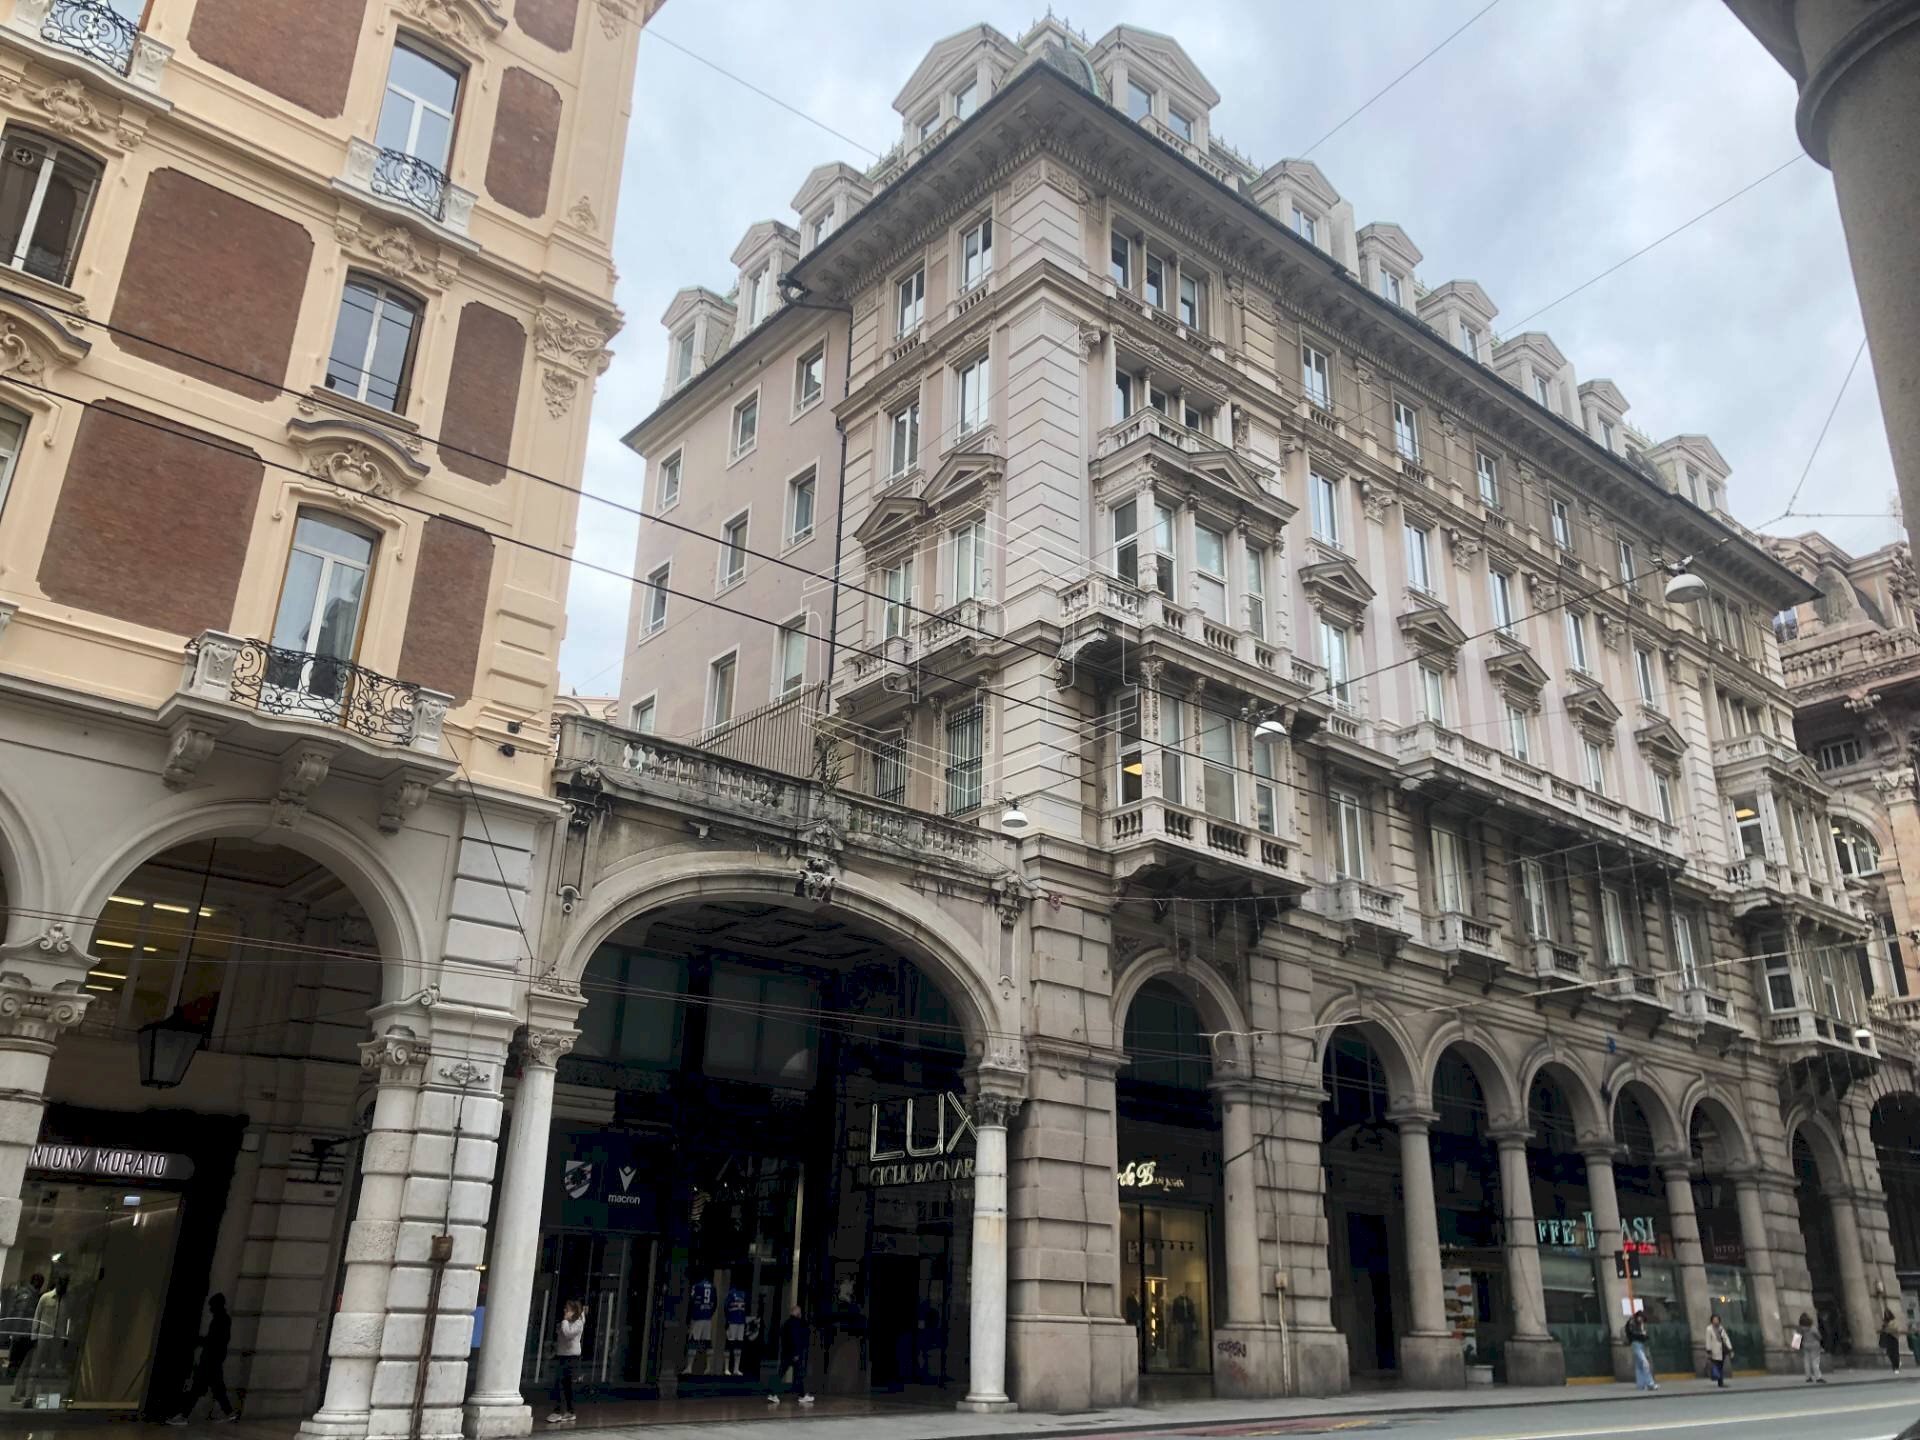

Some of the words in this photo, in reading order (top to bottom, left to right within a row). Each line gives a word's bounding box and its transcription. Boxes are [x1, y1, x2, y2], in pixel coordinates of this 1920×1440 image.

[870, 1091, 979, 1161] LUX
[29, 1145, 88, 1169] NTONY
[95, 1150, 168, 1177] MORATO
[914, 1158, 976, 1182] BAGNAR
[607, 1194, 641, 1206] macron
